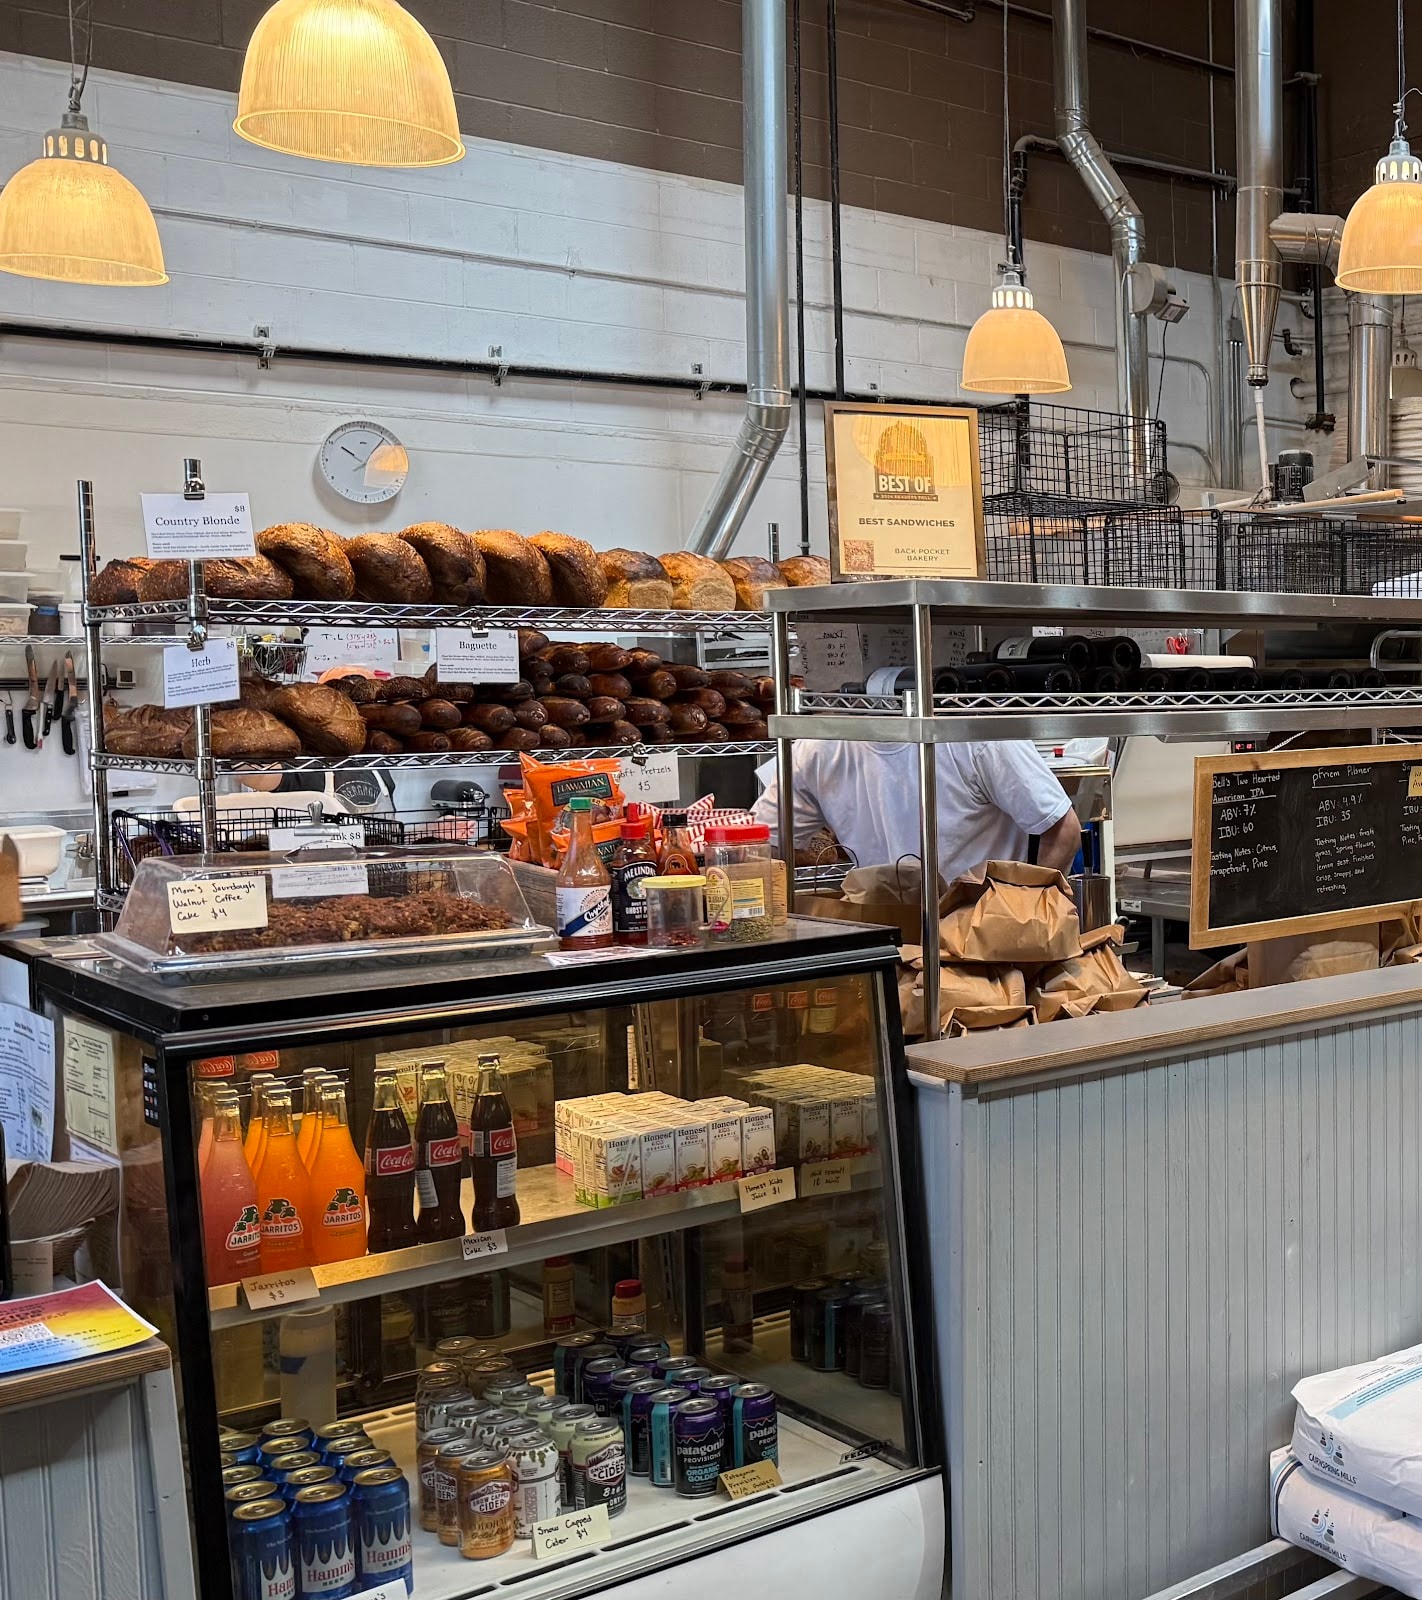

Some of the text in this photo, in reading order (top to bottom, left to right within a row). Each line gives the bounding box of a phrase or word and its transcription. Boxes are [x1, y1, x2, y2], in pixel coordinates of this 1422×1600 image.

[878, 474, 933, 493] BEST OF
[155, 515, 240, 528] Country Blonde
[858, 517, 956, 528] BEST SANDWICHES
[894, 547, 950, 556] BACK POCKET
[907, 554, 938, 562] BAKERY
[459, 640, 497, 651] Baguette
[191, 656, 211, 668] Herb
[640, 765, 672, 777] Pretzels
[556, 776, 607, 794] HAWAIIAN
[638, 780, 651, 792] $5
[1213, 771, 1281, 789] Bell's Two Hearted
[1213, 787, 1265, 803] American IPA
[1318, 799, 1341, 812] ABV:
[1402, 805, 1422, 816] IBU:
[1220, 803, 1257, 821] ABV: 7%
[1315, 809, 1351, 828] IBU: 35
[1217, 822, 1254, 840] IBU: 60
[1400, 823, 1421, 834] Tasting
[349, 831, 361, 841] $8
[1401, 835, 1417, 846] Pine,
[1314, 837, 1337, 848] Tasting
[1234, 848, 1255, 858] Notes:
[1256, 843, 1279, 854] Citrus,
[1252, 857, 1269, 869] Pine
[1316, 862, 1334, 872] lemon
[171, 884, 203, 895] Mom's
[173, 895, 243, 909] Walnut Coffee
[177, 909, 227, 921] Cake $4
[744, 1112, 773, 1124] Honest
[711, 1118, 739, 1131] Honest
[643, 1130, 673, 1142] Honest
[677, 1125, 707, 1137] Honest
[744, 1182, 767, 1193] Honest
[751, 1186, 781, 1200] Juice $1
[324, 1210, 361, 1224] JARRITOS
[261, 1222, 299, 1234] JARRITOS
[231, 1232, 261, 1245] JARRIT
[463, 1235, 493, 1246] Mexican
[488, 1242, 498, 1253] $3
[250, 1278, 296, 1292] Jarritos
[268, 1289, 286, 1301] $3
[749, 1423, 777, 1441] patag
[683, 1452, 722, 1464] PROVISIONS
[590, 1464, 609, 1475] SNOW
[599, 1465, 625, 1480] CIDER
[686, 1463, 720, 1477] ORGANIC
[1308, 1452, 1357, 1485] CAIRNSPRING MILLS
[472, 1497, 490, 1507] SNOW
[479, 1500, 504, 1513] CIDER
[537, 1515, 593, 1536] Snow Capped
[545, 1528, 589, 1550] Cider $4
[366, 1541, 412, 1564] Hamm's
[1299, 1532, 1348, 1562] CAIRNSPRING MILLS
[382, 1558, 404, 1567] BEER
[307, 1560, 355, 1583] Hamm's
[322, 1576, 344, 1587] BEER
